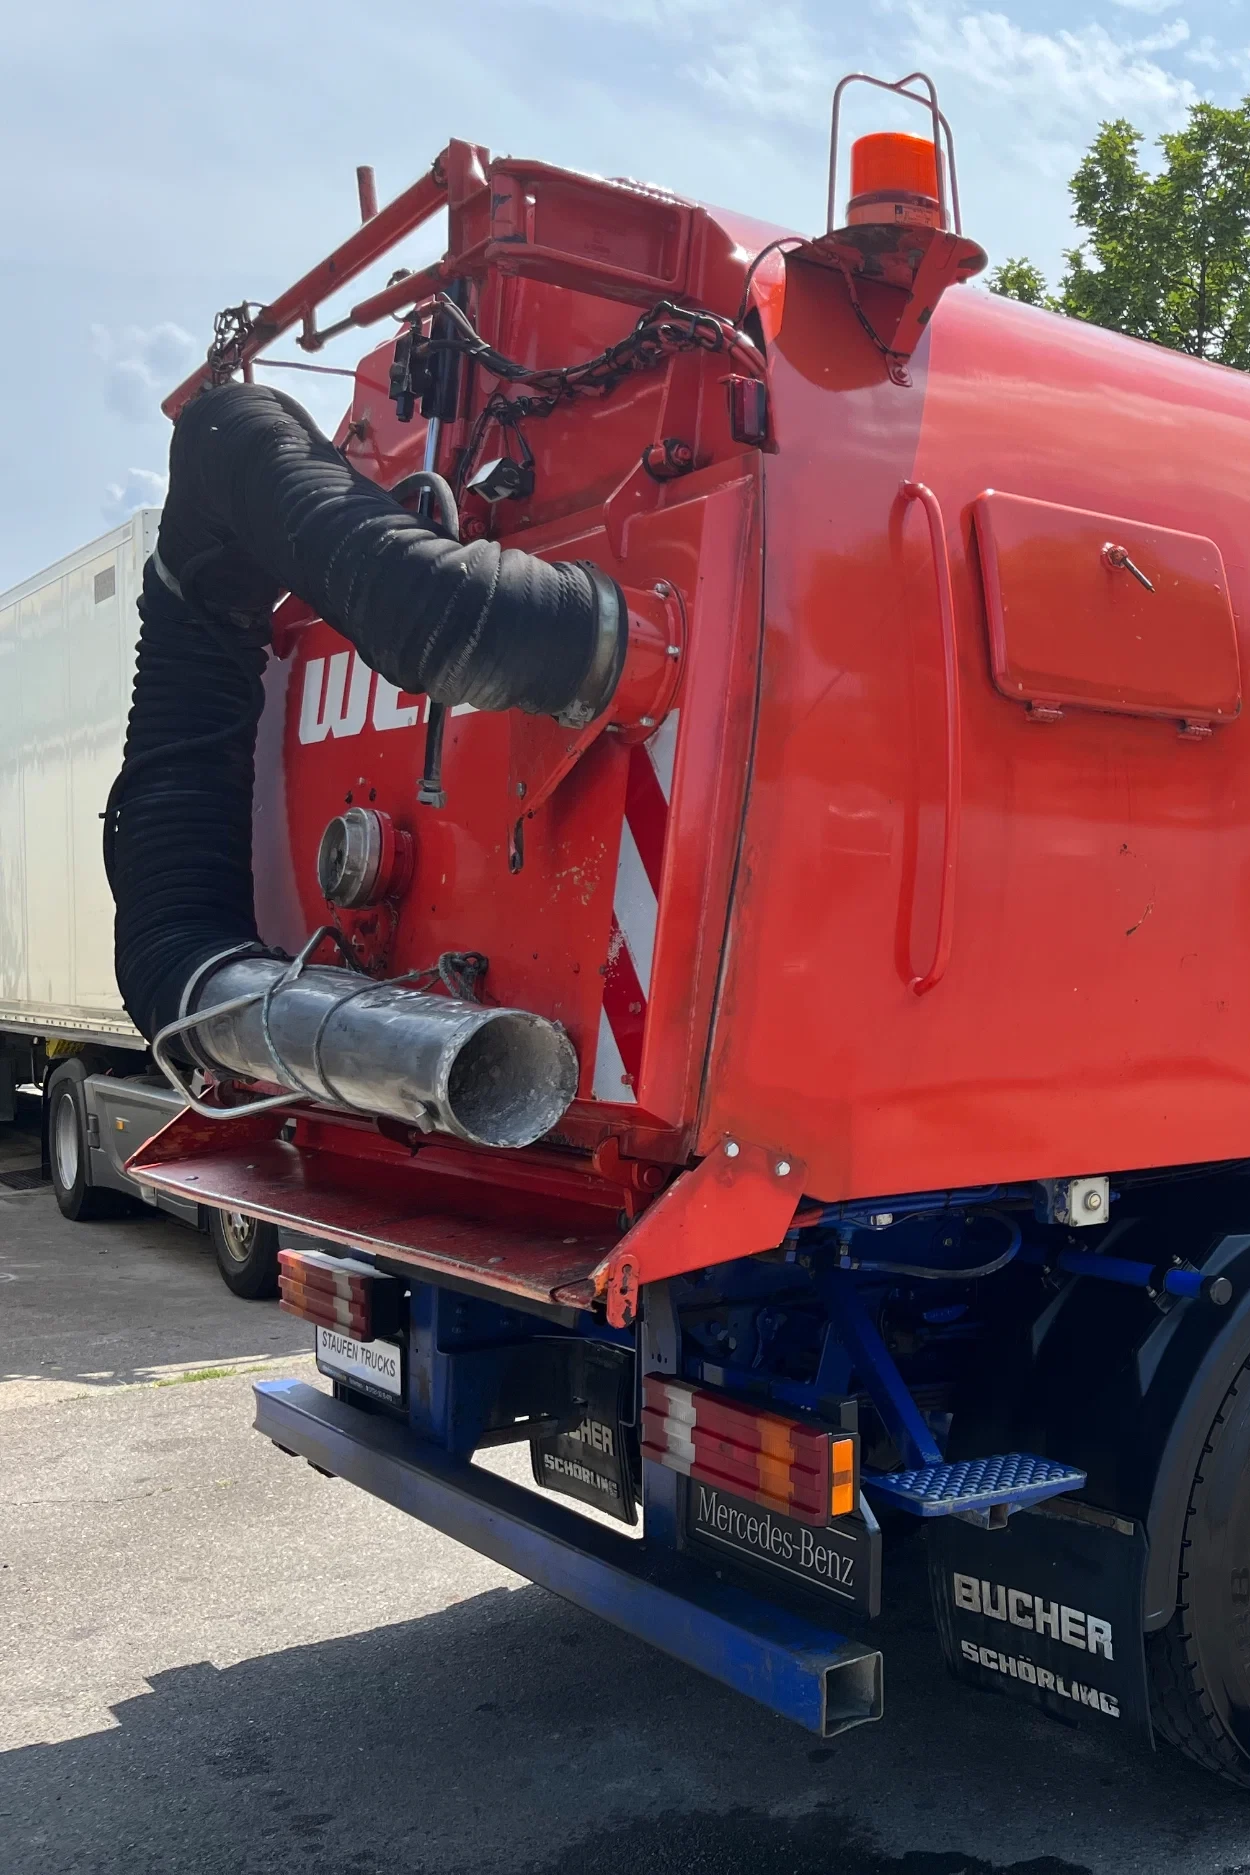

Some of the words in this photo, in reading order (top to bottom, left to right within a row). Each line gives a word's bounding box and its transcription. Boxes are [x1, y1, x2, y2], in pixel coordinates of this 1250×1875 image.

[322, 1330, 359, 1362] STAUFEN
[360, 1347, 396, 1378] TRUCKS
[697, 1486, 854, 1587] Mercedes-Benz
[953, 1572, 1114, 1661] BUCHER
[961, 1639, 1120, 1718] SCHÖRLING
